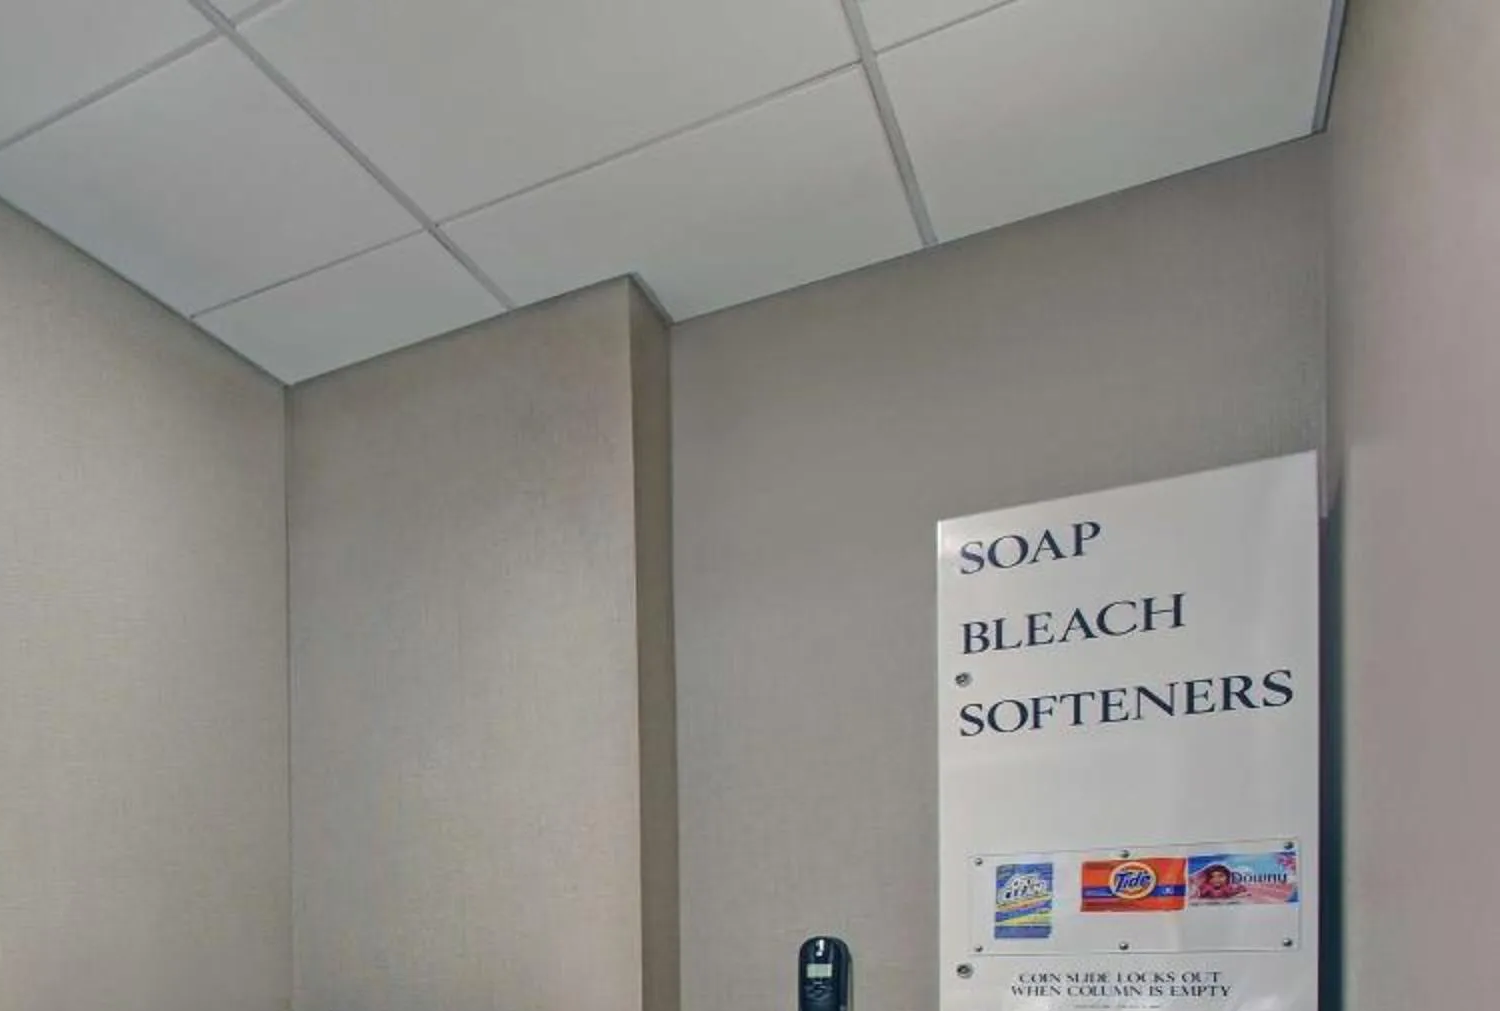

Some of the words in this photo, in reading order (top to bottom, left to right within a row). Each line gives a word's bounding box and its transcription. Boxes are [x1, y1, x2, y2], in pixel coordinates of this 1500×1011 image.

[959, 520, 1102, 576] SOAP
[961, 592, 1187, 655] BLEACH
[959, 668, 1295, 737] SOFTENERS
[1114, 871, 1152, 893] Tide
[1230, 869, 1288, 887] Downy
[1018, 971, 1062, 983] COIN
[1116, 971, 1176, 983] LOCKS
[1181, 971, 1223, 983] OUT
[1011, 985, 1062, 997] WHEN
[1066, 985, 1142, 997] COLUMN
[1149, 985, 1164, 997] IS
[1170, 984, 1233, 998] EMPTY
